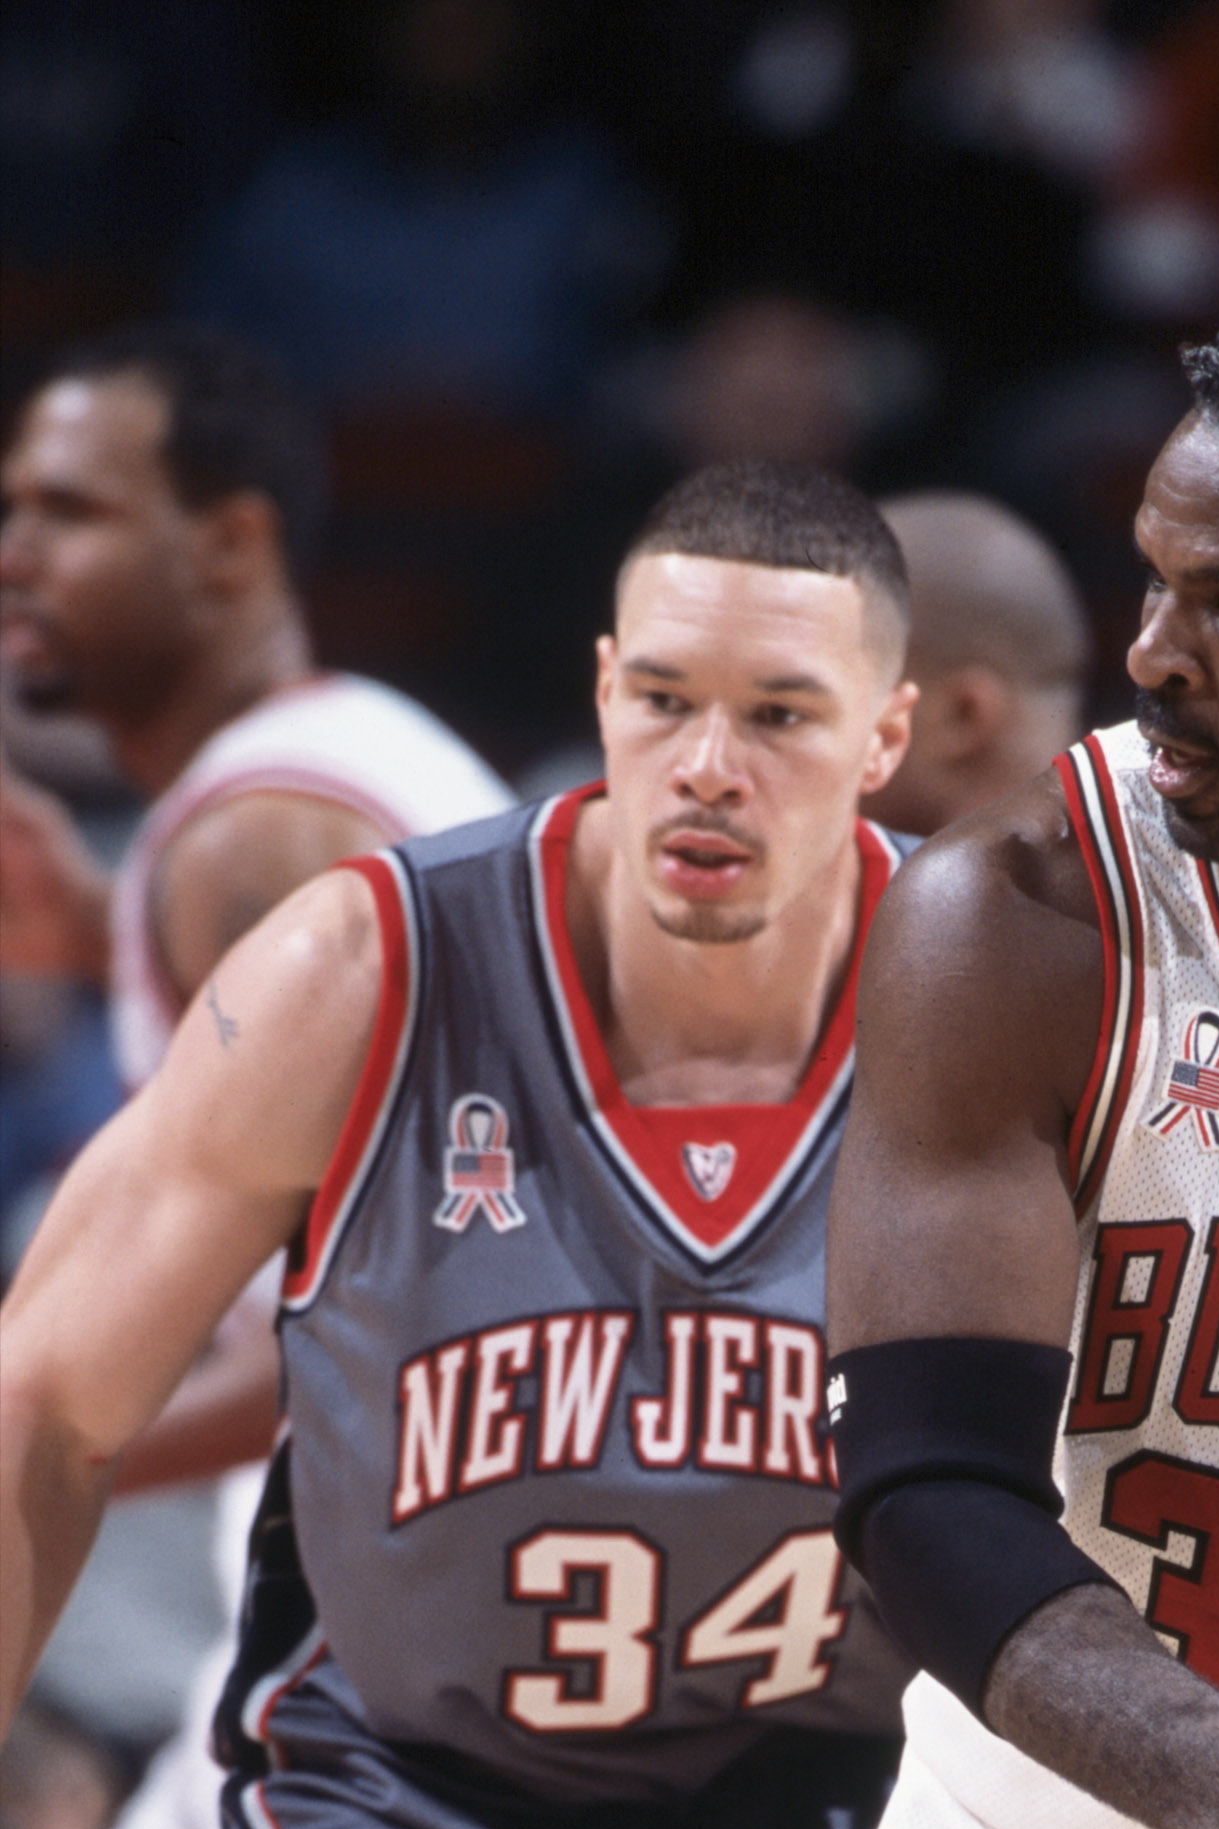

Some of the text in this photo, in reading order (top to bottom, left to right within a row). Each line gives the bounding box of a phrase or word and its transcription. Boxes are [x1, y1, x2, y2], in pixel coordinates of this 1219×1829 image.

[391, 1309, 840, 1529] NEW JER
[503, 1525, 849, 1733] 34
